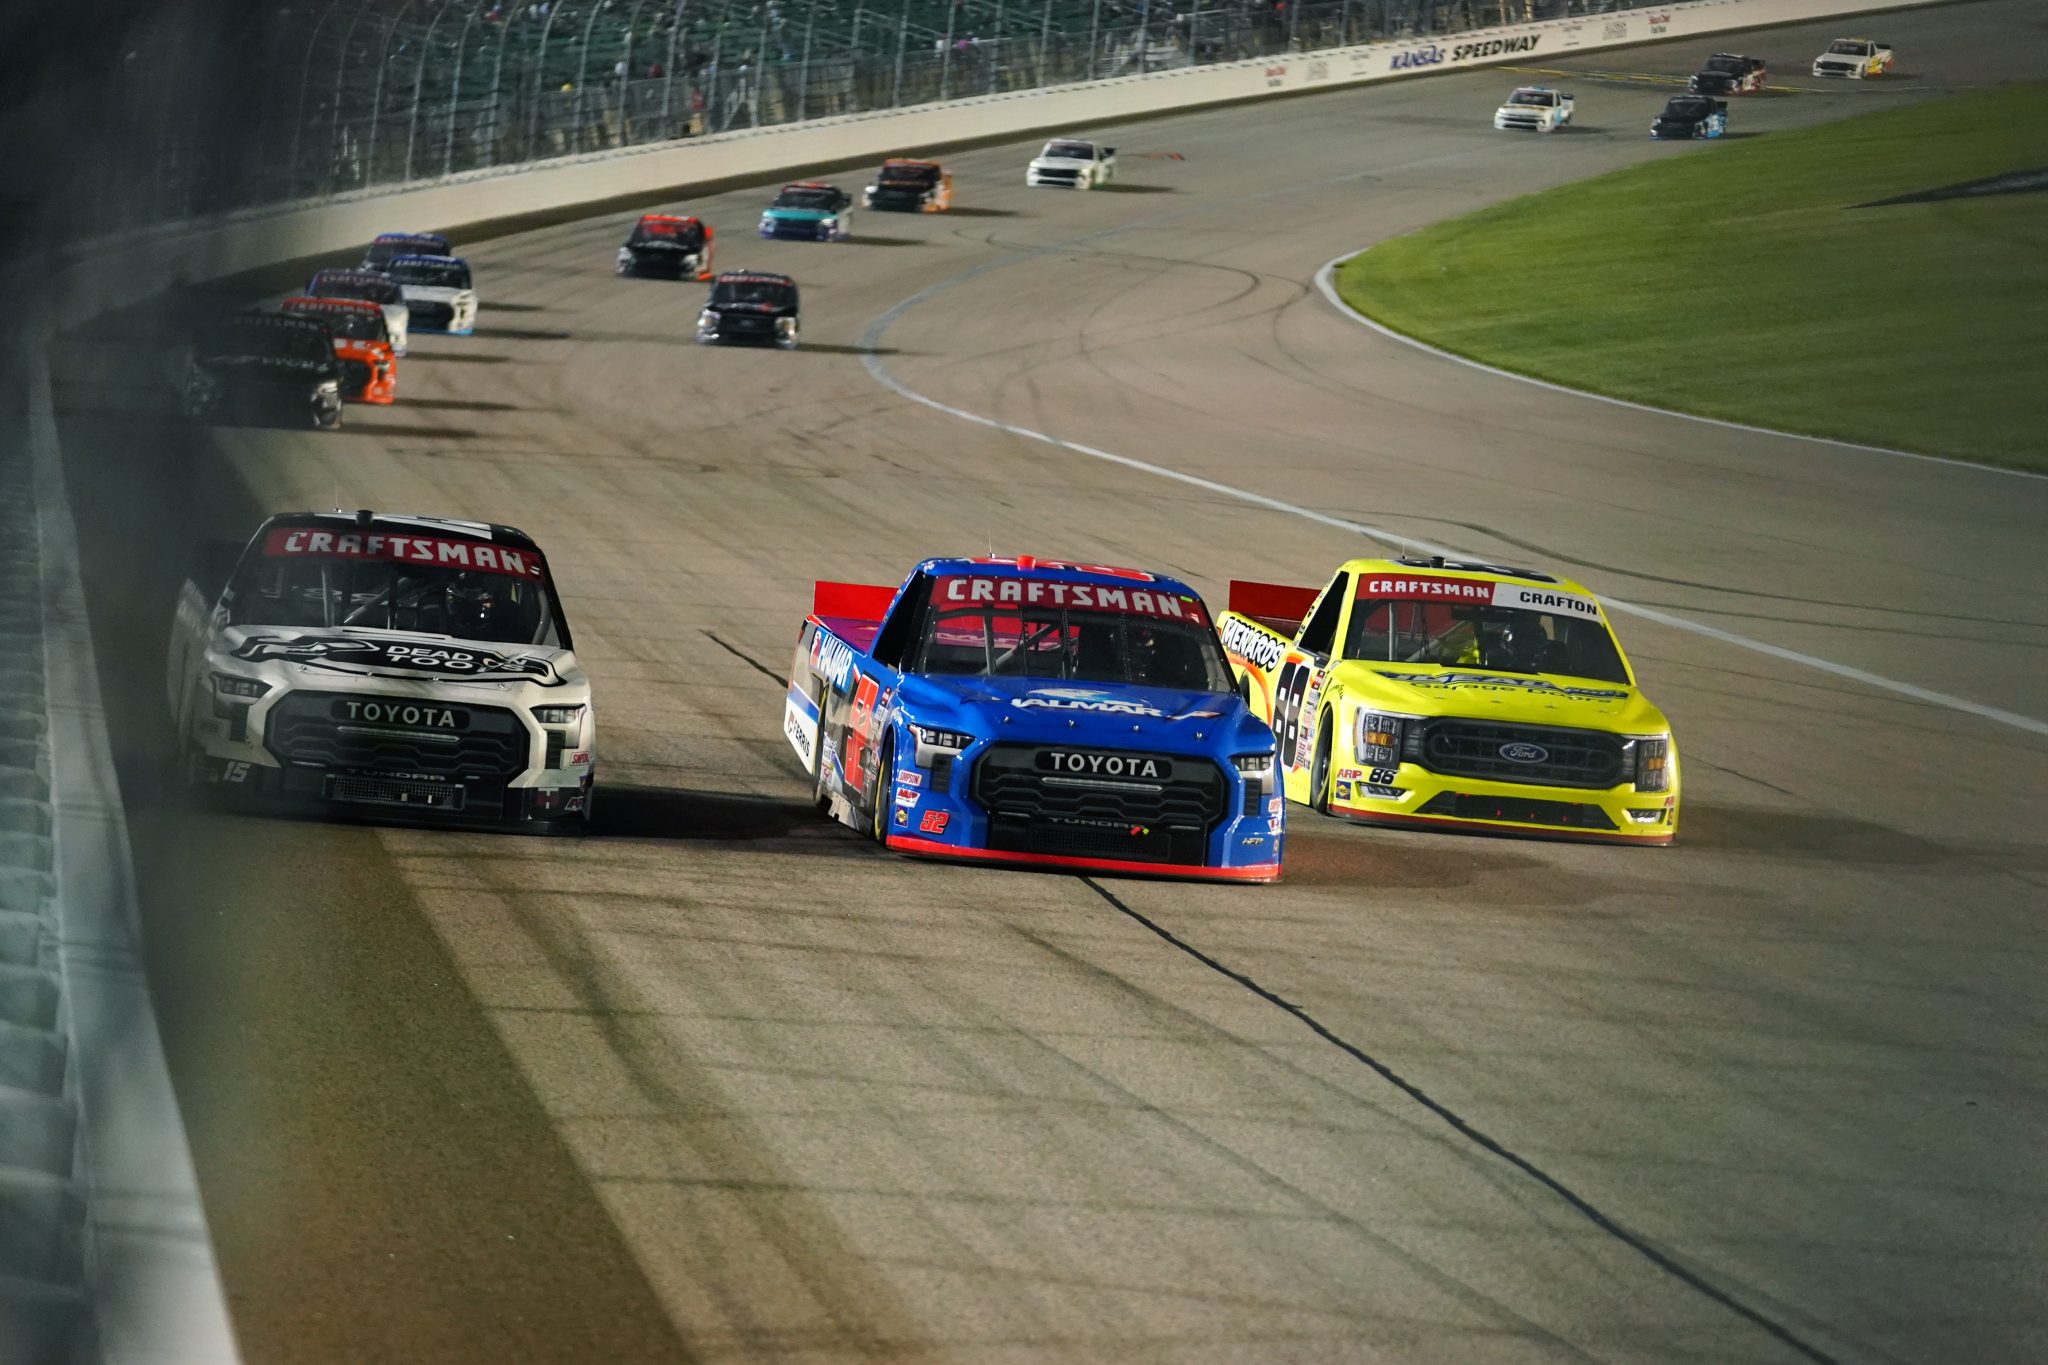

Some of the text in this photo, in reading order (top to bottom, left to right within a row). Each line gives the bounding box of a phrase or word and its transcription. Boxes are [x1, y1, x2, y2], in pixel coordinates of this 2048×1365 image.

[1390, 34, 1541, 71] KANSAS SPEEDWAY
[284, 532, 526, 574] CRAFTSMAN
[947, 580, 1182, 617] CRAFTSMAN
[1369, 580, 1489, 598] CRAFTSMAN
[1520, 591, 1597, 616] CRAFTON
[386, 645, 473, 661] DEAD
[1221, 616, 1285, 671] MENARDS
[817, 634, 852, 688] HALMAR
[347, 701, 456, 728] TOYOTA
[793, 718, 811, 757] FERRIS
[1050, 752, 1158, 778] TOYOTA
[1509, 745, 1537, 759] Ford
[223, 760, 252, 783] 15
[347, 768, 446, 781] TUNDRA
[920, 810, 950, 833] 52
